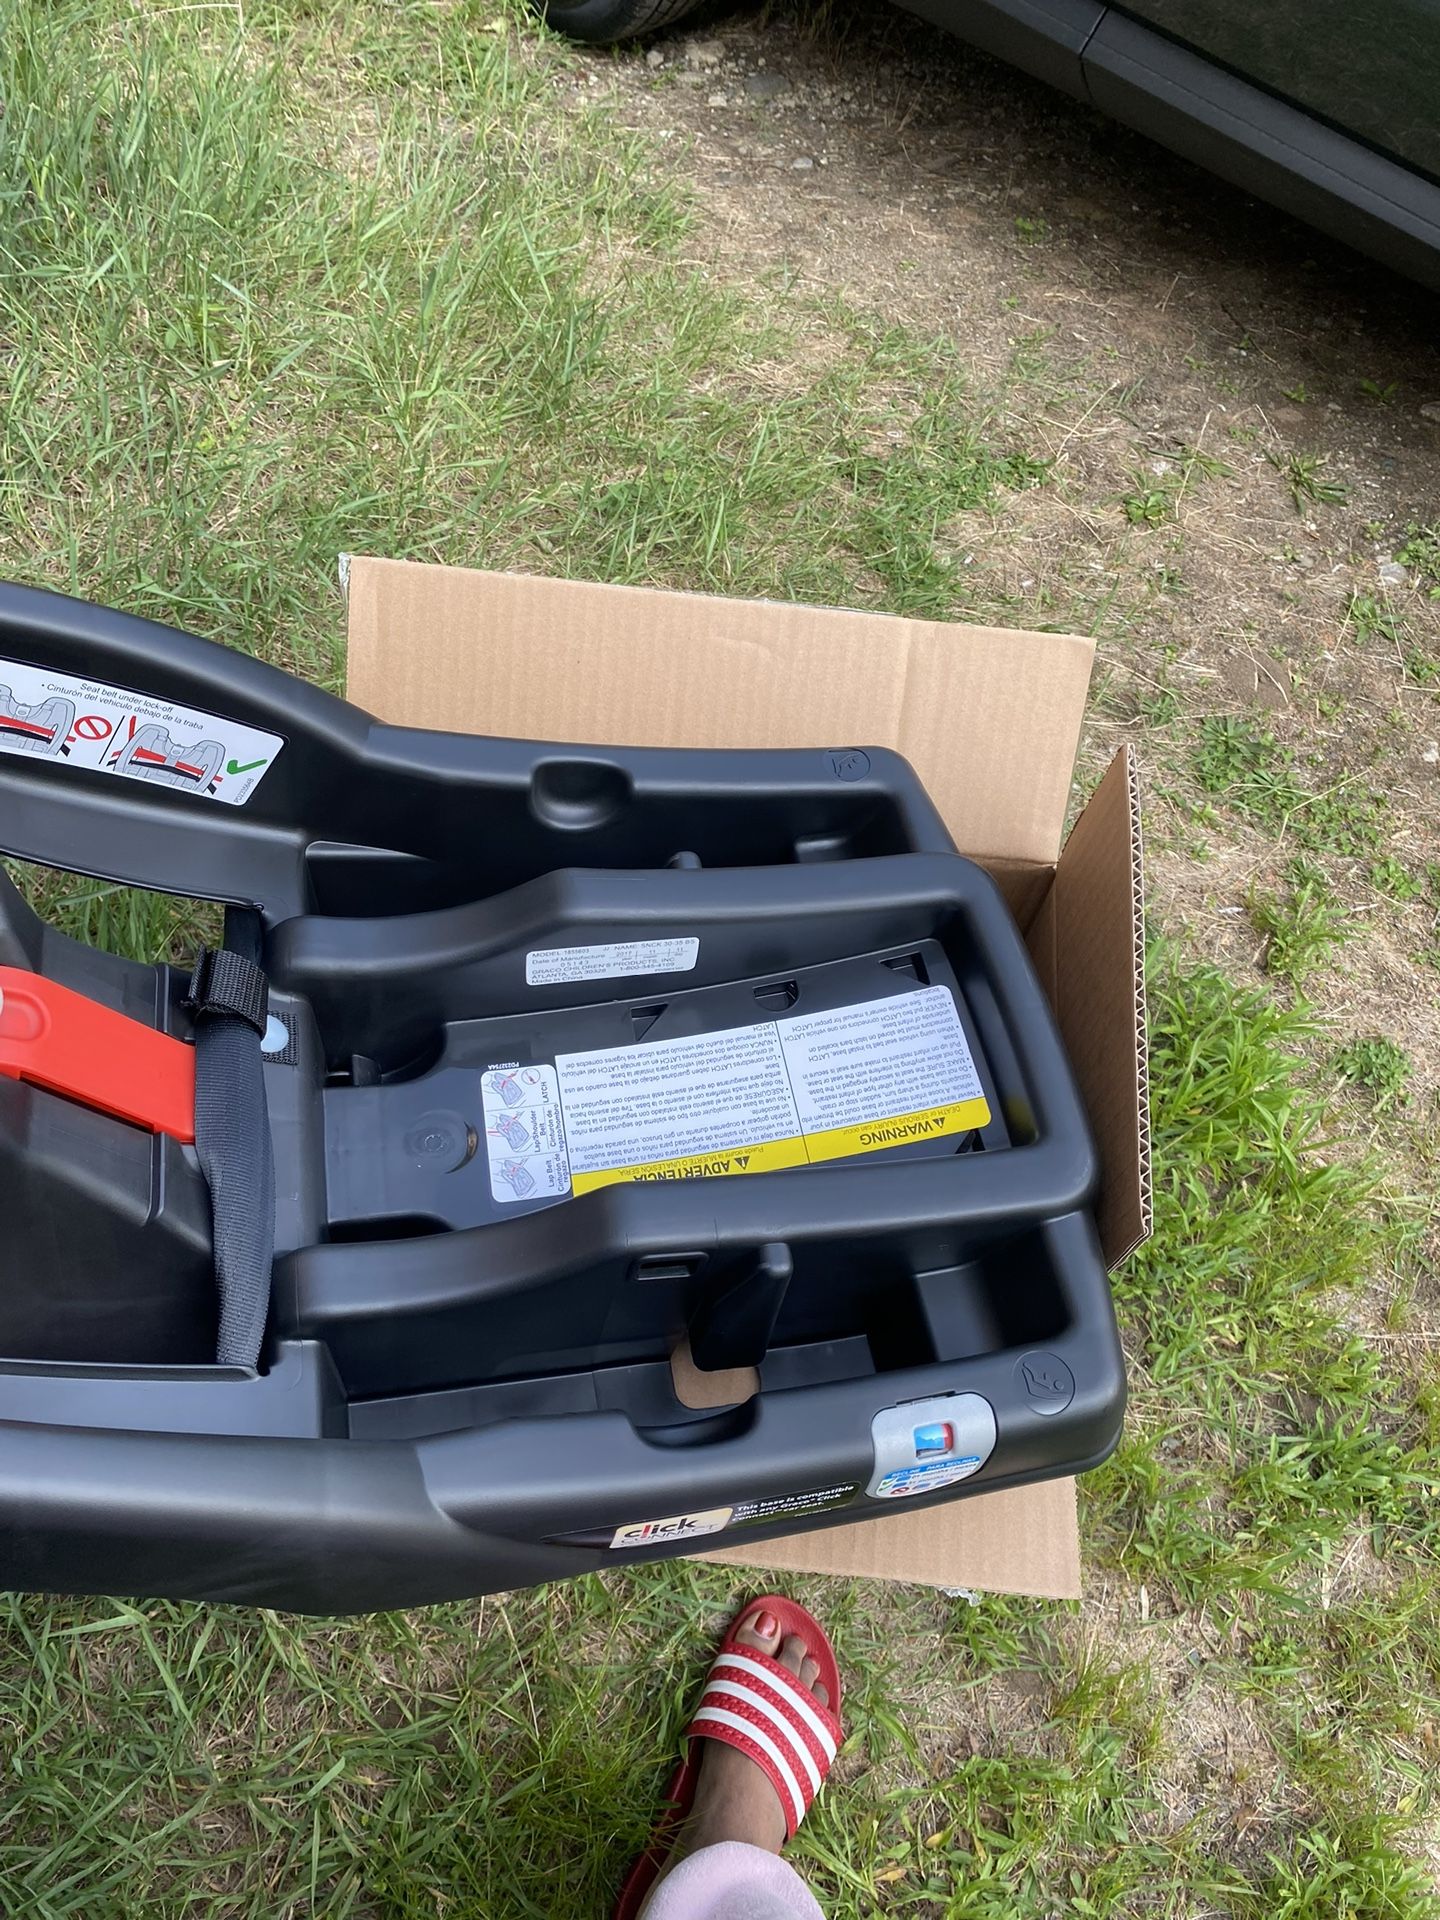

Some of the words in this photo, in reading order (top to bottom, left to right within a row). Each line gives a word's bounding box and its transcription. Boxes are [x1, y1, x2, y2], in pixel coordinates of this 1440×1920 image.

[80, 682, 101, 693] Seat
[102, 688, 118, 697] belt
[119, 694, 142, 704] under
[144, 699, 174, 712] lock-off
[47, 683, 83, 697] Cinturón
[85, 693, 98, 701] del
[134, 706, 161, 718] debajo
[163, 713, 173, 721] de
[184, 719, 204, 729] traba
[884, 1037, 897, 1045] seat
[898, 1033, 919, 1041] vehicle
[808, 1052, 830, 1062] LATCH
[945, 1057, 965, 1066] MAKE
[925, 1061, 945, 1070] SURE
[900, 1068, 914, 1076] seat
[947, 1067, 957, 1075] not
[868, 1073, 893, 1082] securely
[905, 1076, 918, 1084] with
[919, 1072, 935, 1080] base
[940, 1073, 971, 1084] occupants
[841, 1078, 868, 1089] engaged
[862, 1084, 877, 1092] type
[920, 1080, 940, 1088] during
[541, 1081, 549, 1103] LATCH
[838, 1090, 855, 1098] infant
[858, 1093, 881, 1102] sudden
[936, 1105, 960, 1116] DEATH
[747, 1115, 769, 1124] golpear
[897, 1112, 929, 1124] SERIOUS
[709, 1122, 740, 1131] ocupantes
[873, 1119, 898, 1130] INJURY
[547, 1119, 557, 1147] Cinturón
[685, 1127, 709, 1135] durante
[713, 1130, 737, 1138] sistema
[859, 1120, 931, 1145] WARNING
[604, 1139, 626, 1148] parada
[673, 1136, 704, 1146] seguridad
[743, 1146, 763, 1155] Puede
[583, 1152, 605, 1160] sueltos
[688, 1154, 717, 1165] MUERTE
[555, 1164, 565, 1192] Cinturón
[760, 1499, 784, 1507] base
[796, 1485, 854, 1499] compatible
[817, 1493, 841, 1501] Click
[624, 1518, 698, 1539] click
